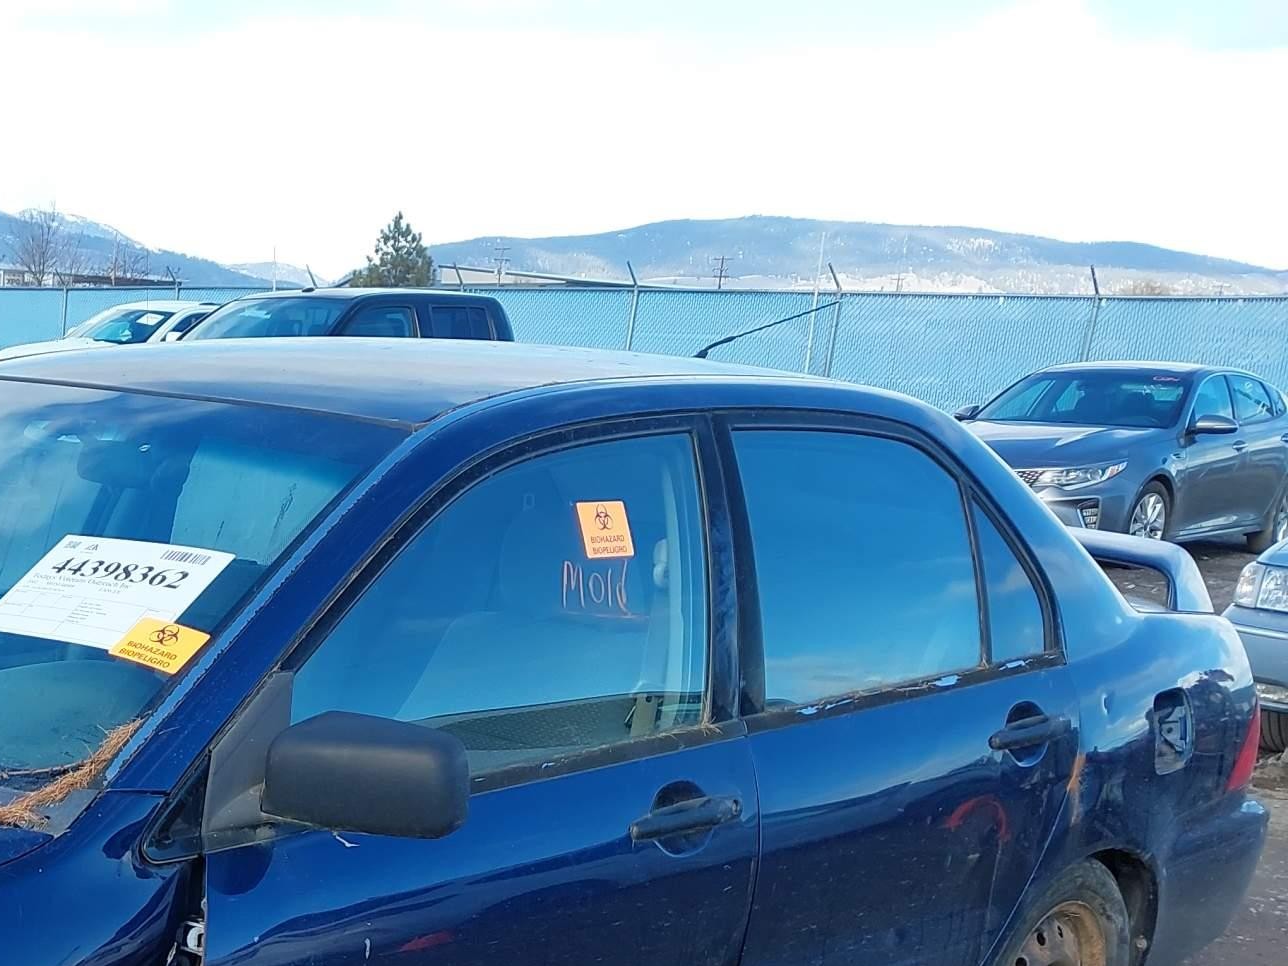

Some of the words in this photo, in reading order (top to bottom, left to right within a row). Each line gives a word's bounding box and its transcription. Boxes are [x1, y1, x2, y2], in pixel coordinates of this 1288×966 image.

[591, 534, 625, 544] BIOHAZARD
[592, 545, 628, 554] BIOPELIGRO
[52, 557, 190, 589] 44398362
[119, 647, 171, 669] BIOPELIGRO
[127, 640, 178, 661] BIOHAZARD
